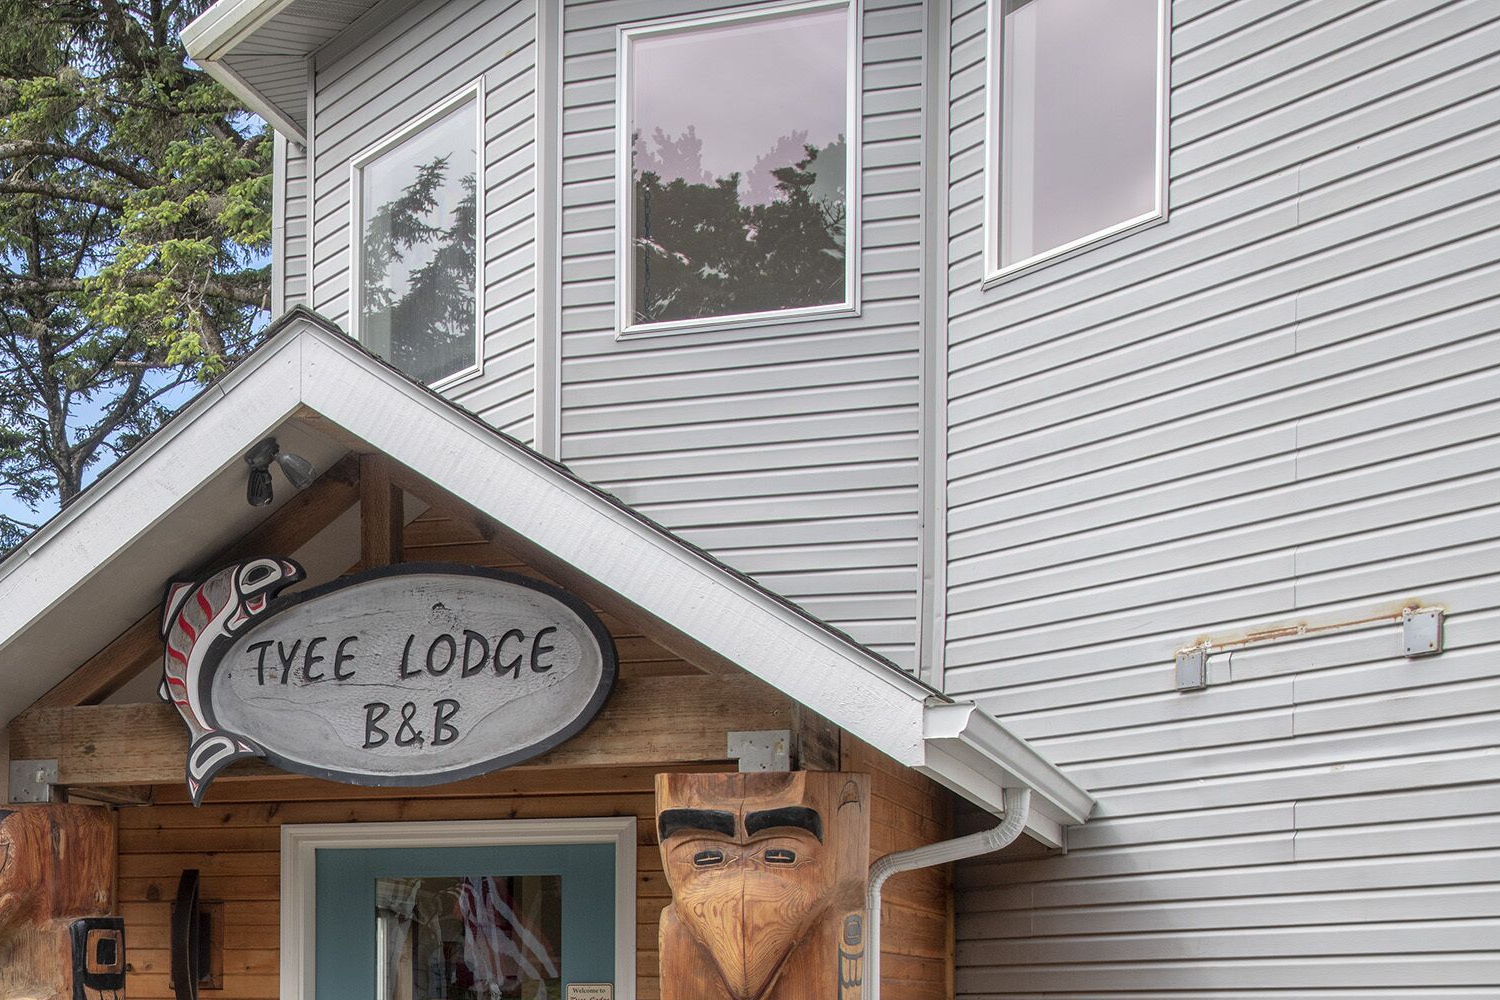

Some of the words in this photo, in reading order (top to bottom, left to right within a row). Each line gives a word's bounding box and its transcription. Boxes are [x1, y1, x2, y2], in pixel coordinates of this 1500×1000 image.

[246, 636, 358, 686] TYEE
[400, 626, 559, 681] LODGE
[362, 699, 460, 749] B&B
